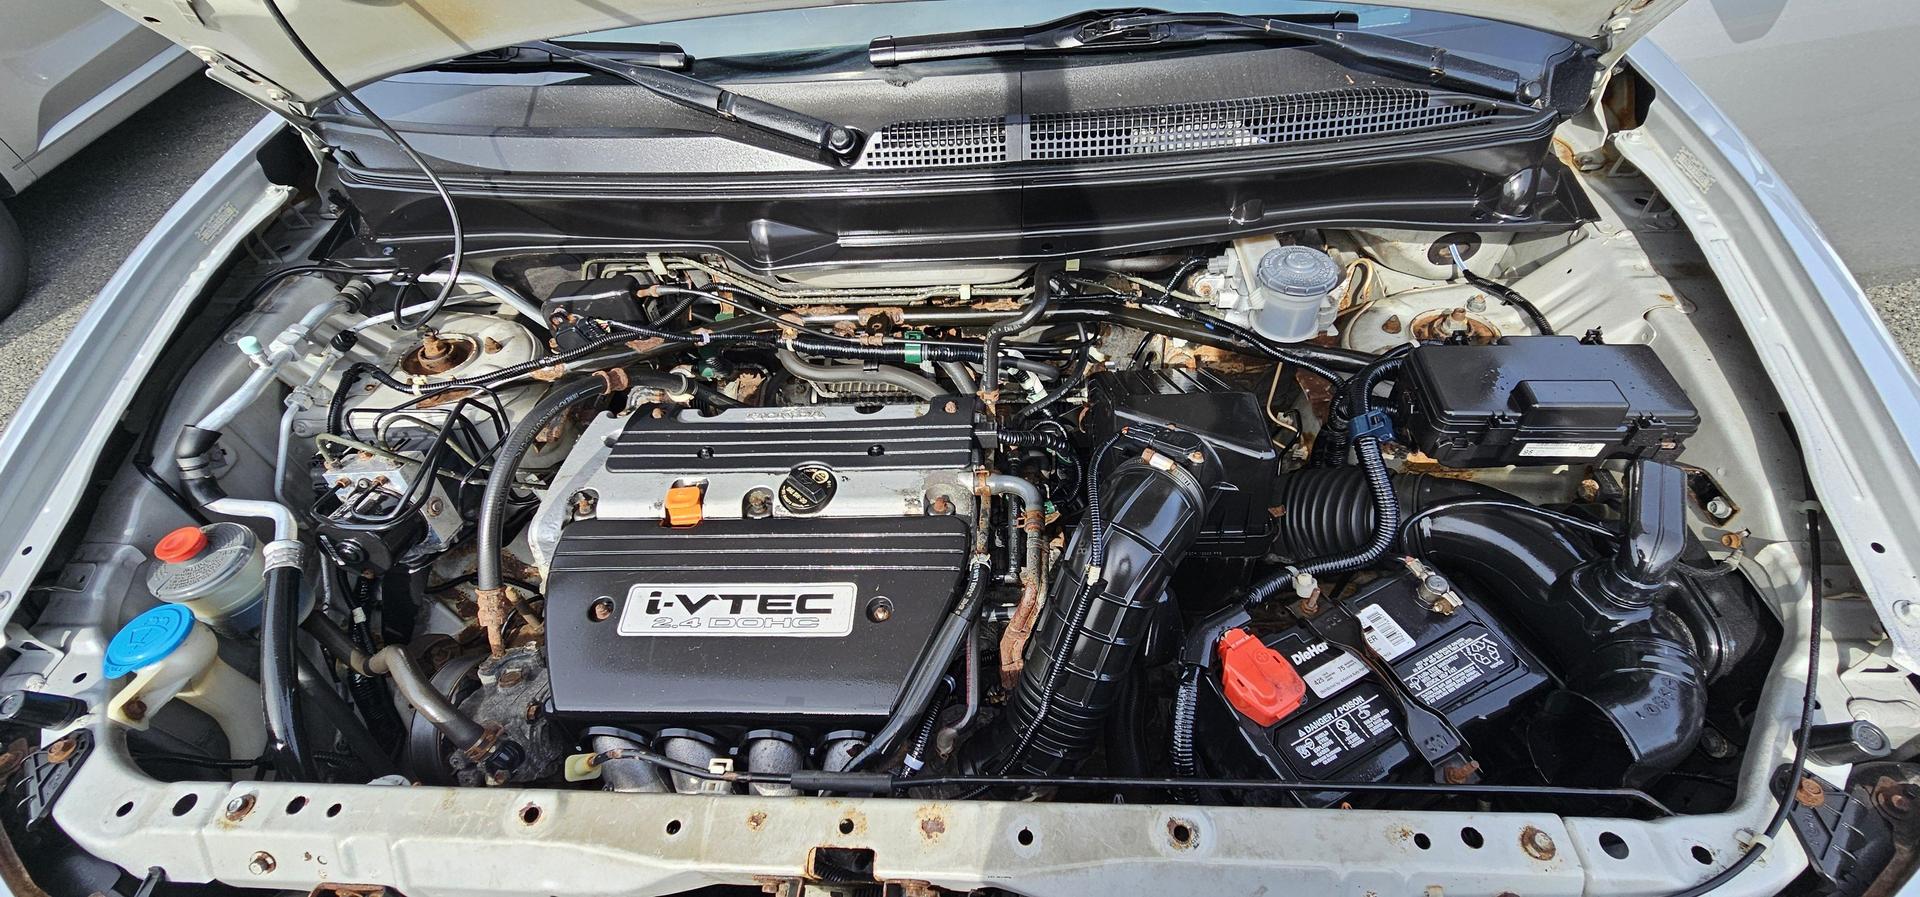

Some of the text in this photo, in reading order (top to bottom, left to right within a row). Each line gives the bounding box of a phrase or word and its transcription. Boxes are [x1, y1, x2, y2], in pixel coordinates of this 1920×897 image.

[645, 591, 835, 616] i-VTEC
[651, 616, 820, 629] 2.4 DOHC
[1290, 641, 1329, 666] DieHar
[1303, 713, 1334, 733] DANGER
[1338, 696, 1365, 714] POISON
